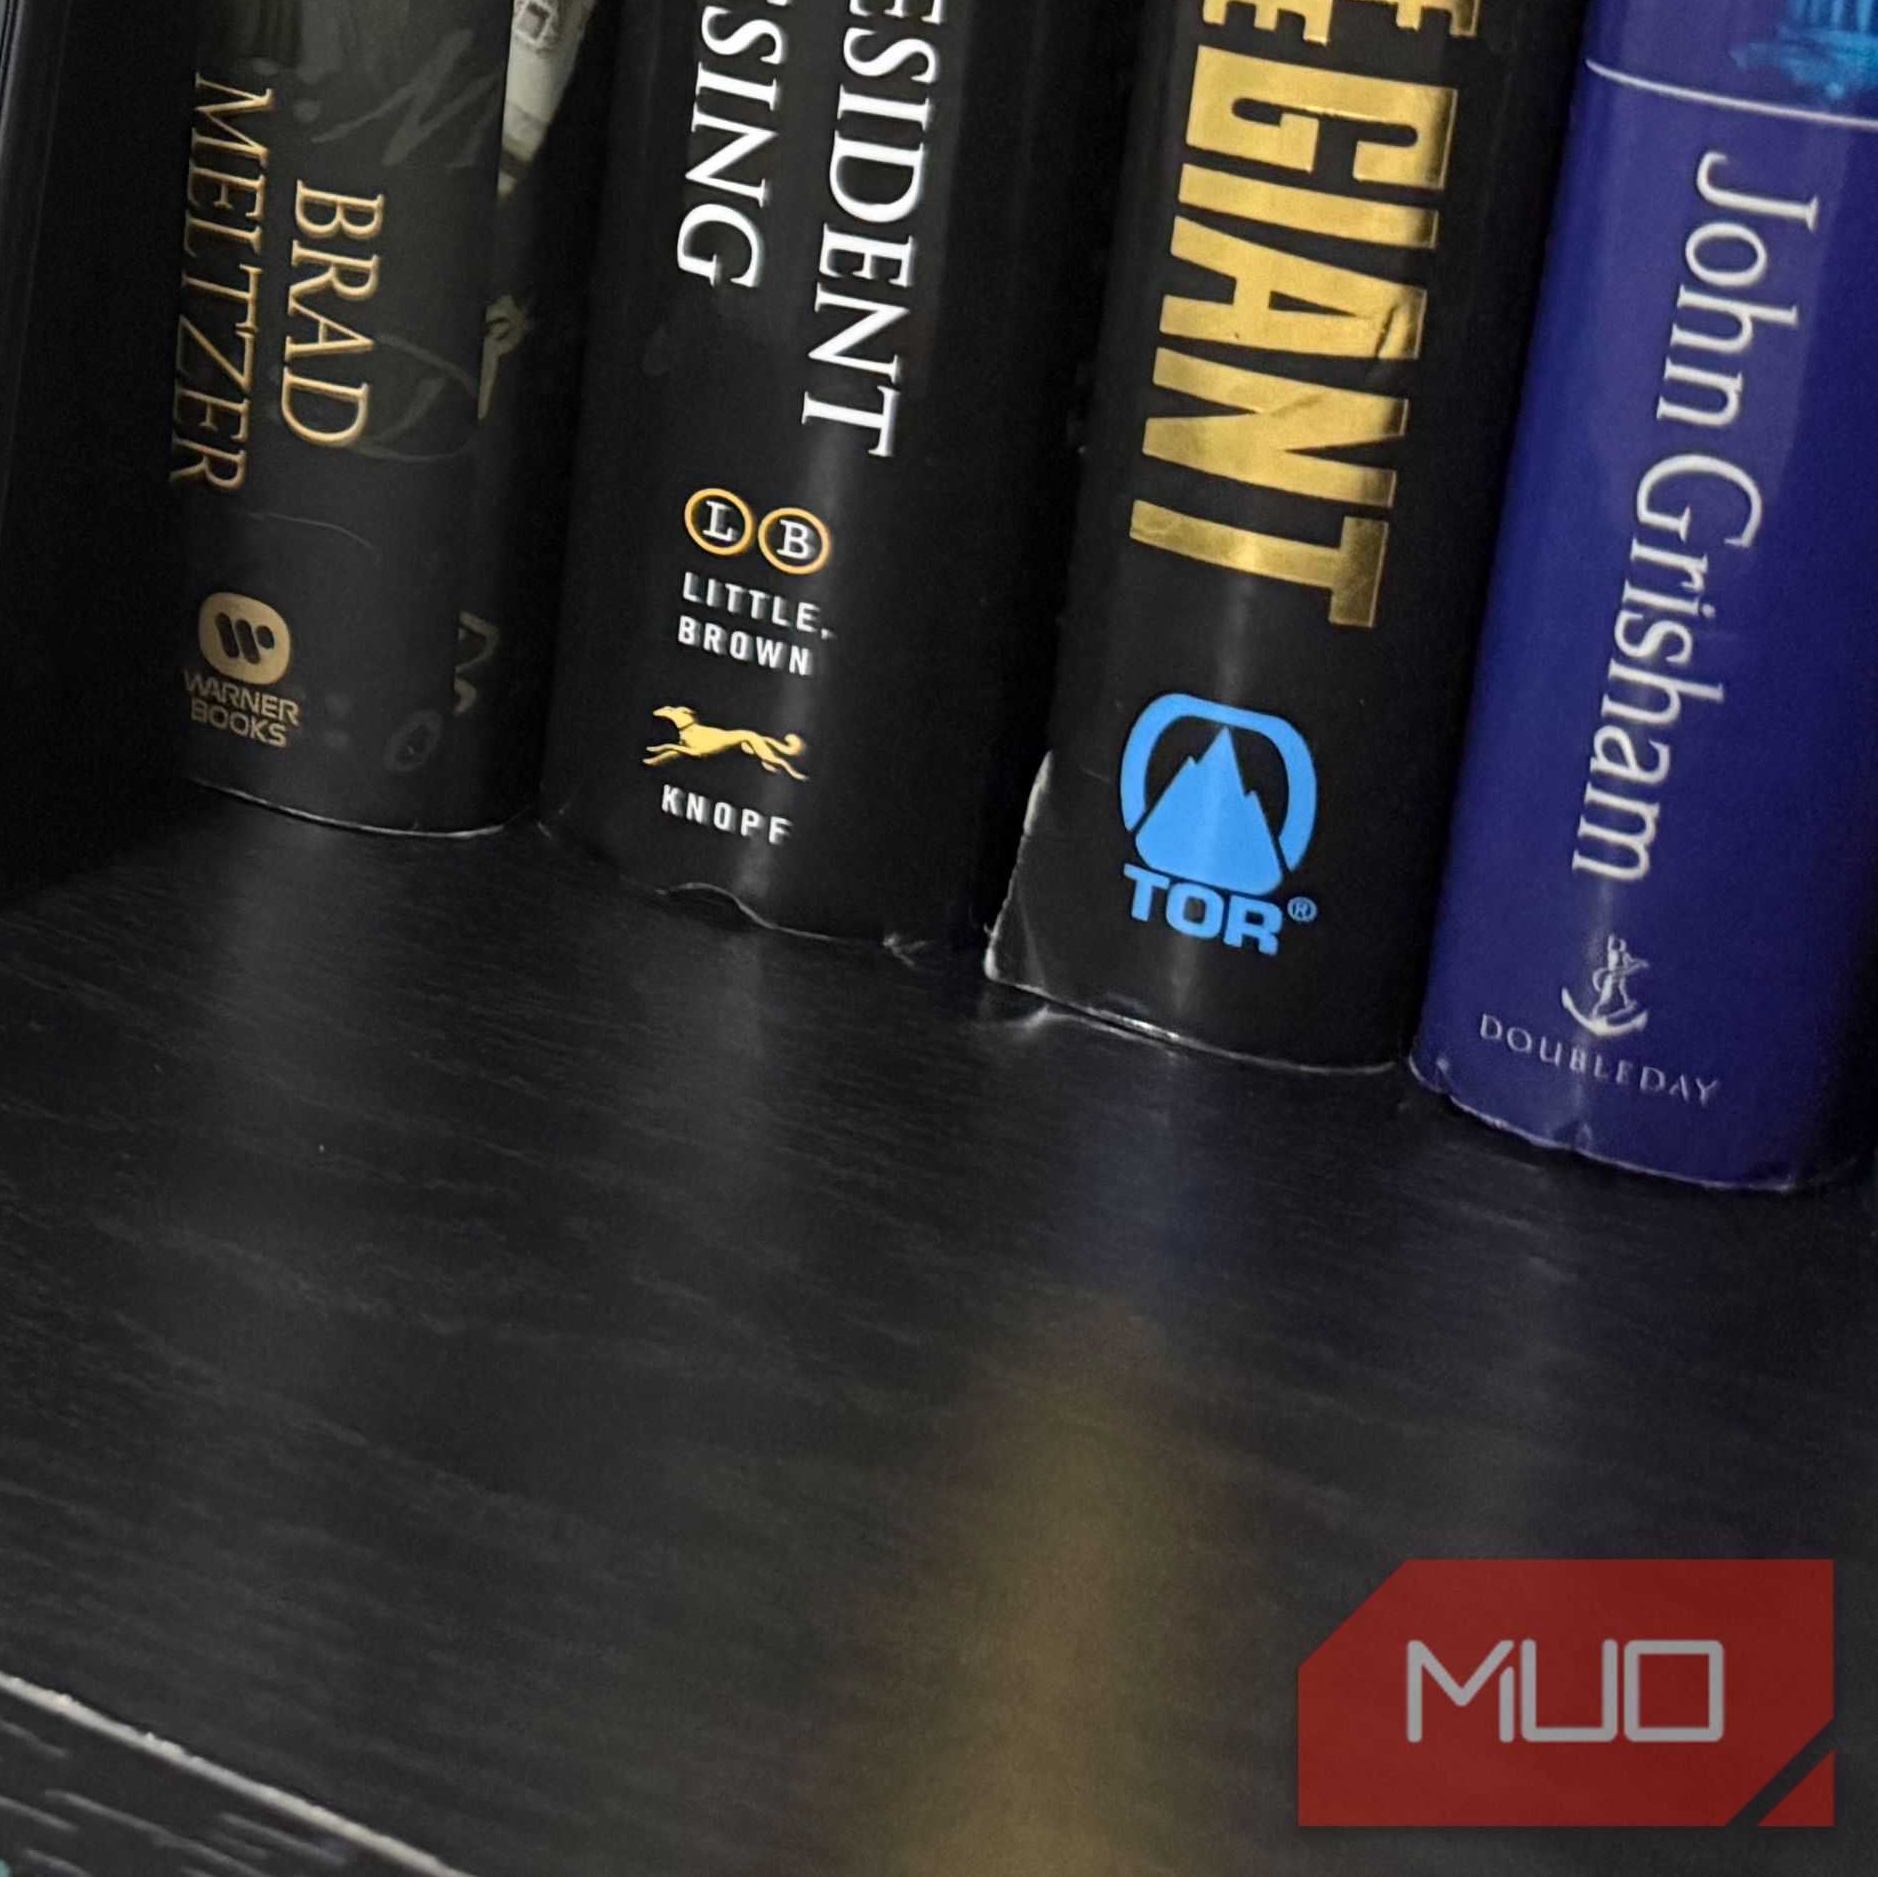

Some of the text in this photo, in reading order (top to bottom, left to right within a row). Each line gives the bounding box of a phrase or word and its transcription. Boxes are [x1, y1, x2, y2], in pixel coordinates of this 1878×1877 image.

[170, 72, 275, 493] MELTZER
[280, 179, 385, 448] BRAD
[1129, 41, 1457, 628] GIANT
[1570, 151, 1820, 887] John Grisham
[676, 614, 812, 677] BROWN
[183, 668, 301, 726] WARNER
[190, 698, 287, 749] BOOKS
[659, 782, 791, 846] KNOPF
[1479, 1011, 1721, 1108] DOUBLEDAY
